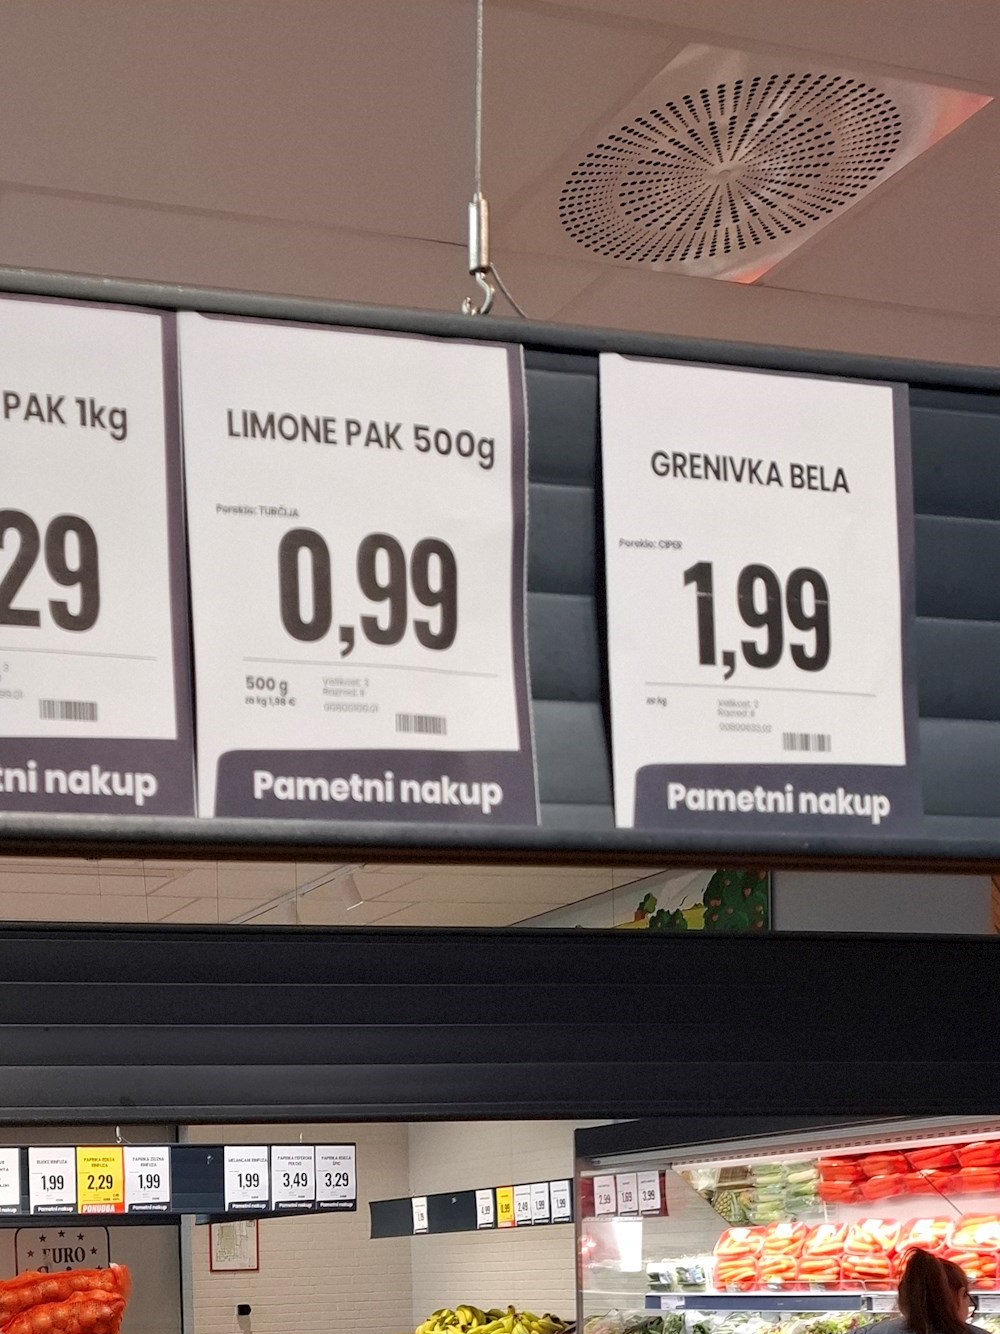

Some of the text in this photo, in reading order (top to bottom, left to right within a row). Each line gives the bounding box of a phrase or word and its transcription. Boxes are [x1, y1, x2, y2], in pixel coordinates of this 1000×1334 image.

[3, 391, 66, 426] PAK
[77, 398, 129, 442] 1kg
[226, 408, 497, 471] LIMONE PAK 500g
[651, 450, 851, 494] GRENIVKA BELA
[277, 526, 459, 658] 0,99
[682, 560, 832, 681] 1,99
[245, 675, 288, 697] 500 g
[288, 698, 297, 707] €
[45, 766, 158, 806] nakup
[253, 770, 504, 814] Pametni nakup
[667, 782, 892, 825] Pametni nakup
[40, 1175, 64, 1192] 1,99
[87, 1174, 113, 1191] 2,29
[138, 1174, 160, 1190] 1,99
[237, 1173, 260, 1189] 1,99
[283, 1172, 308, 1189] 3,49
[325, 1172, 349, 1188] 3,29
[82, 1204, 116, 1212] PONUDBA
